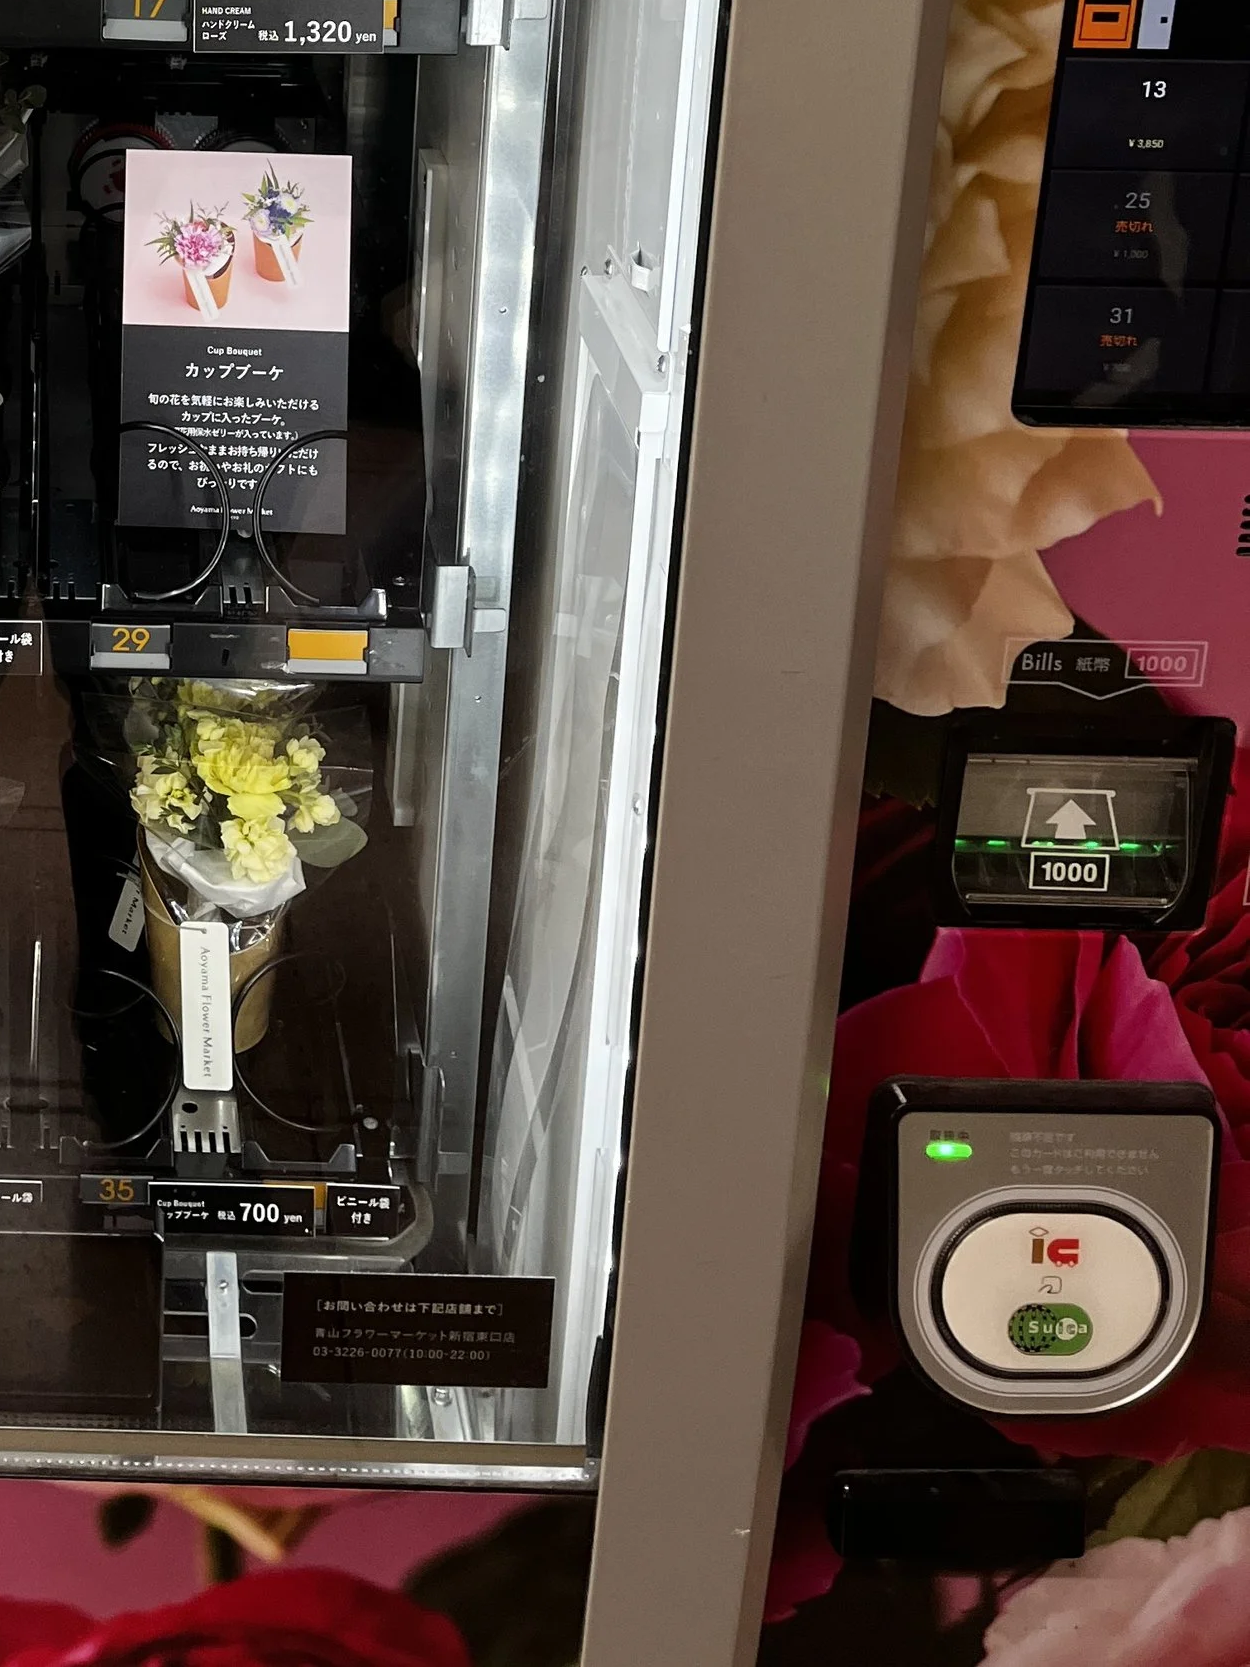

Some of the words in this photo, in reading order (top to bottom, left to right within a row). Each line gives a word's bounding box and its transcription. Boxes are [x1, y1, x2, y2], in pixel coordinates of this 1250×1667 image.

[202, 6, 223, 15] HAND
[225, 7, 251, 15] CREAM
[201, 19, 255, 31] ハンドクリーム
[202, 30, 227, 41] ローズ
[258, 30, 279, 42] 税込
[283, 20, 352, 45] 1,320
[355, 32, 377, 44] yen
[1141, 80, 1168, 98] 13
[1125, 191, 1151, 210] 25
[1114, 220, 1154, 233] 売切れ
[1109, 307, 1134, 325] 31
[1099, 334, 1139, 348] 売切れ
[207, 346, 225, 356] Cup
[226, 346, 263, 357] Bouquet
[185, 362, 284, 381] カップブーケ
[148, 392, 320, 411] 旬の花を気軽にお楽しみいただける
[181, 411, 286, 426] カップに入ったブーケ。
[112, 627, 151, 652] 29
[1021, 652, 1063, 672] Bills
[1075, 656, 1111, 673] 紙幣
[1137, 655, 1188, 673] 1000
[1041, 862, 1099, 883] 1000
[200, 946, 211, 992] Aoyama
[201, 994, 212, 1033] Flower
[202, 1036, 213, 1078] Market
[100, 1178, 134, 1202] 35
[157, 1198, 172, 1208] Cup
[173, 1199, 205, 1208] Bouquet
[336, 1195, 391, 1210] ビニール袋
[350, 1212, 372, 1225] 付き
[1028, 1319, 1089, 1336] Suica
